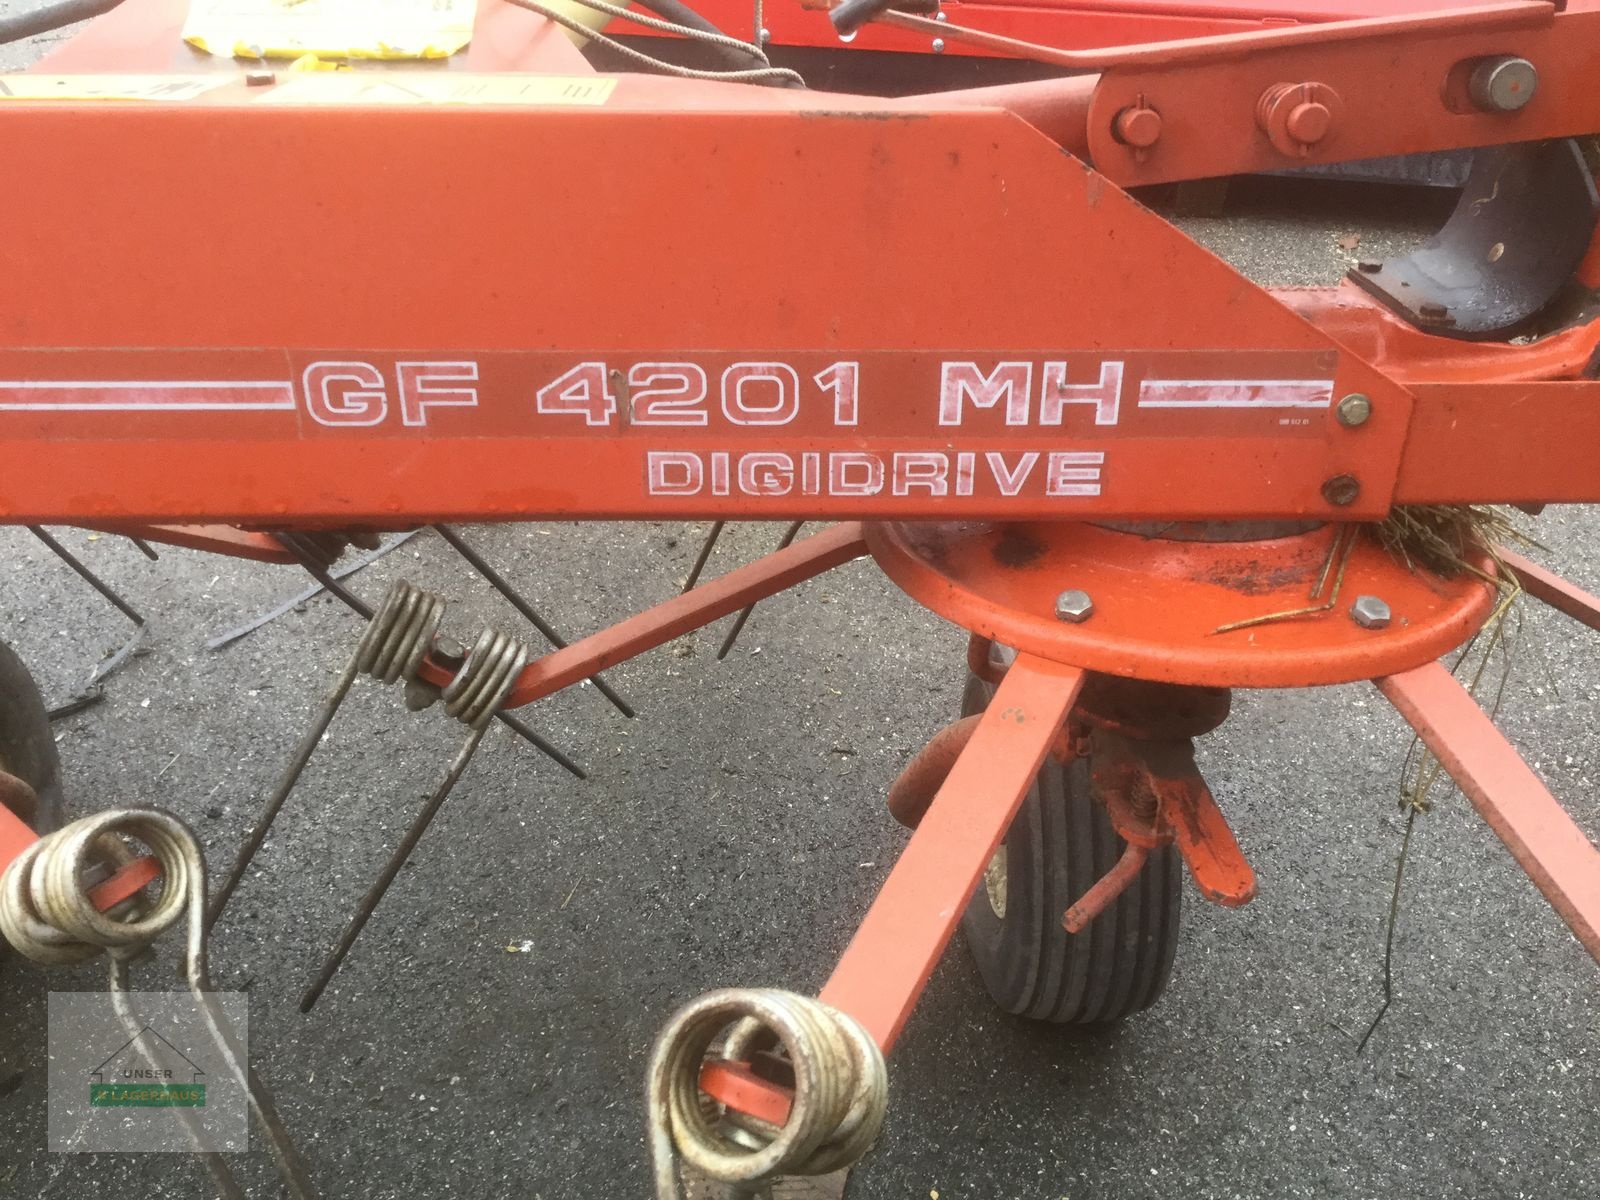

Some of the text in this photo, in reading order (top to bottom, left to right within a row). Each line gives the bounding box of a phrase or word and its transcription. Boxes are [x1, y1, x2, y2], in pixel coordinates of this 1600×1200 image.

[302, 361, 1125, 427] GF 4201 MH
[647, 451, 1105, 497] DIGIDRIVE
